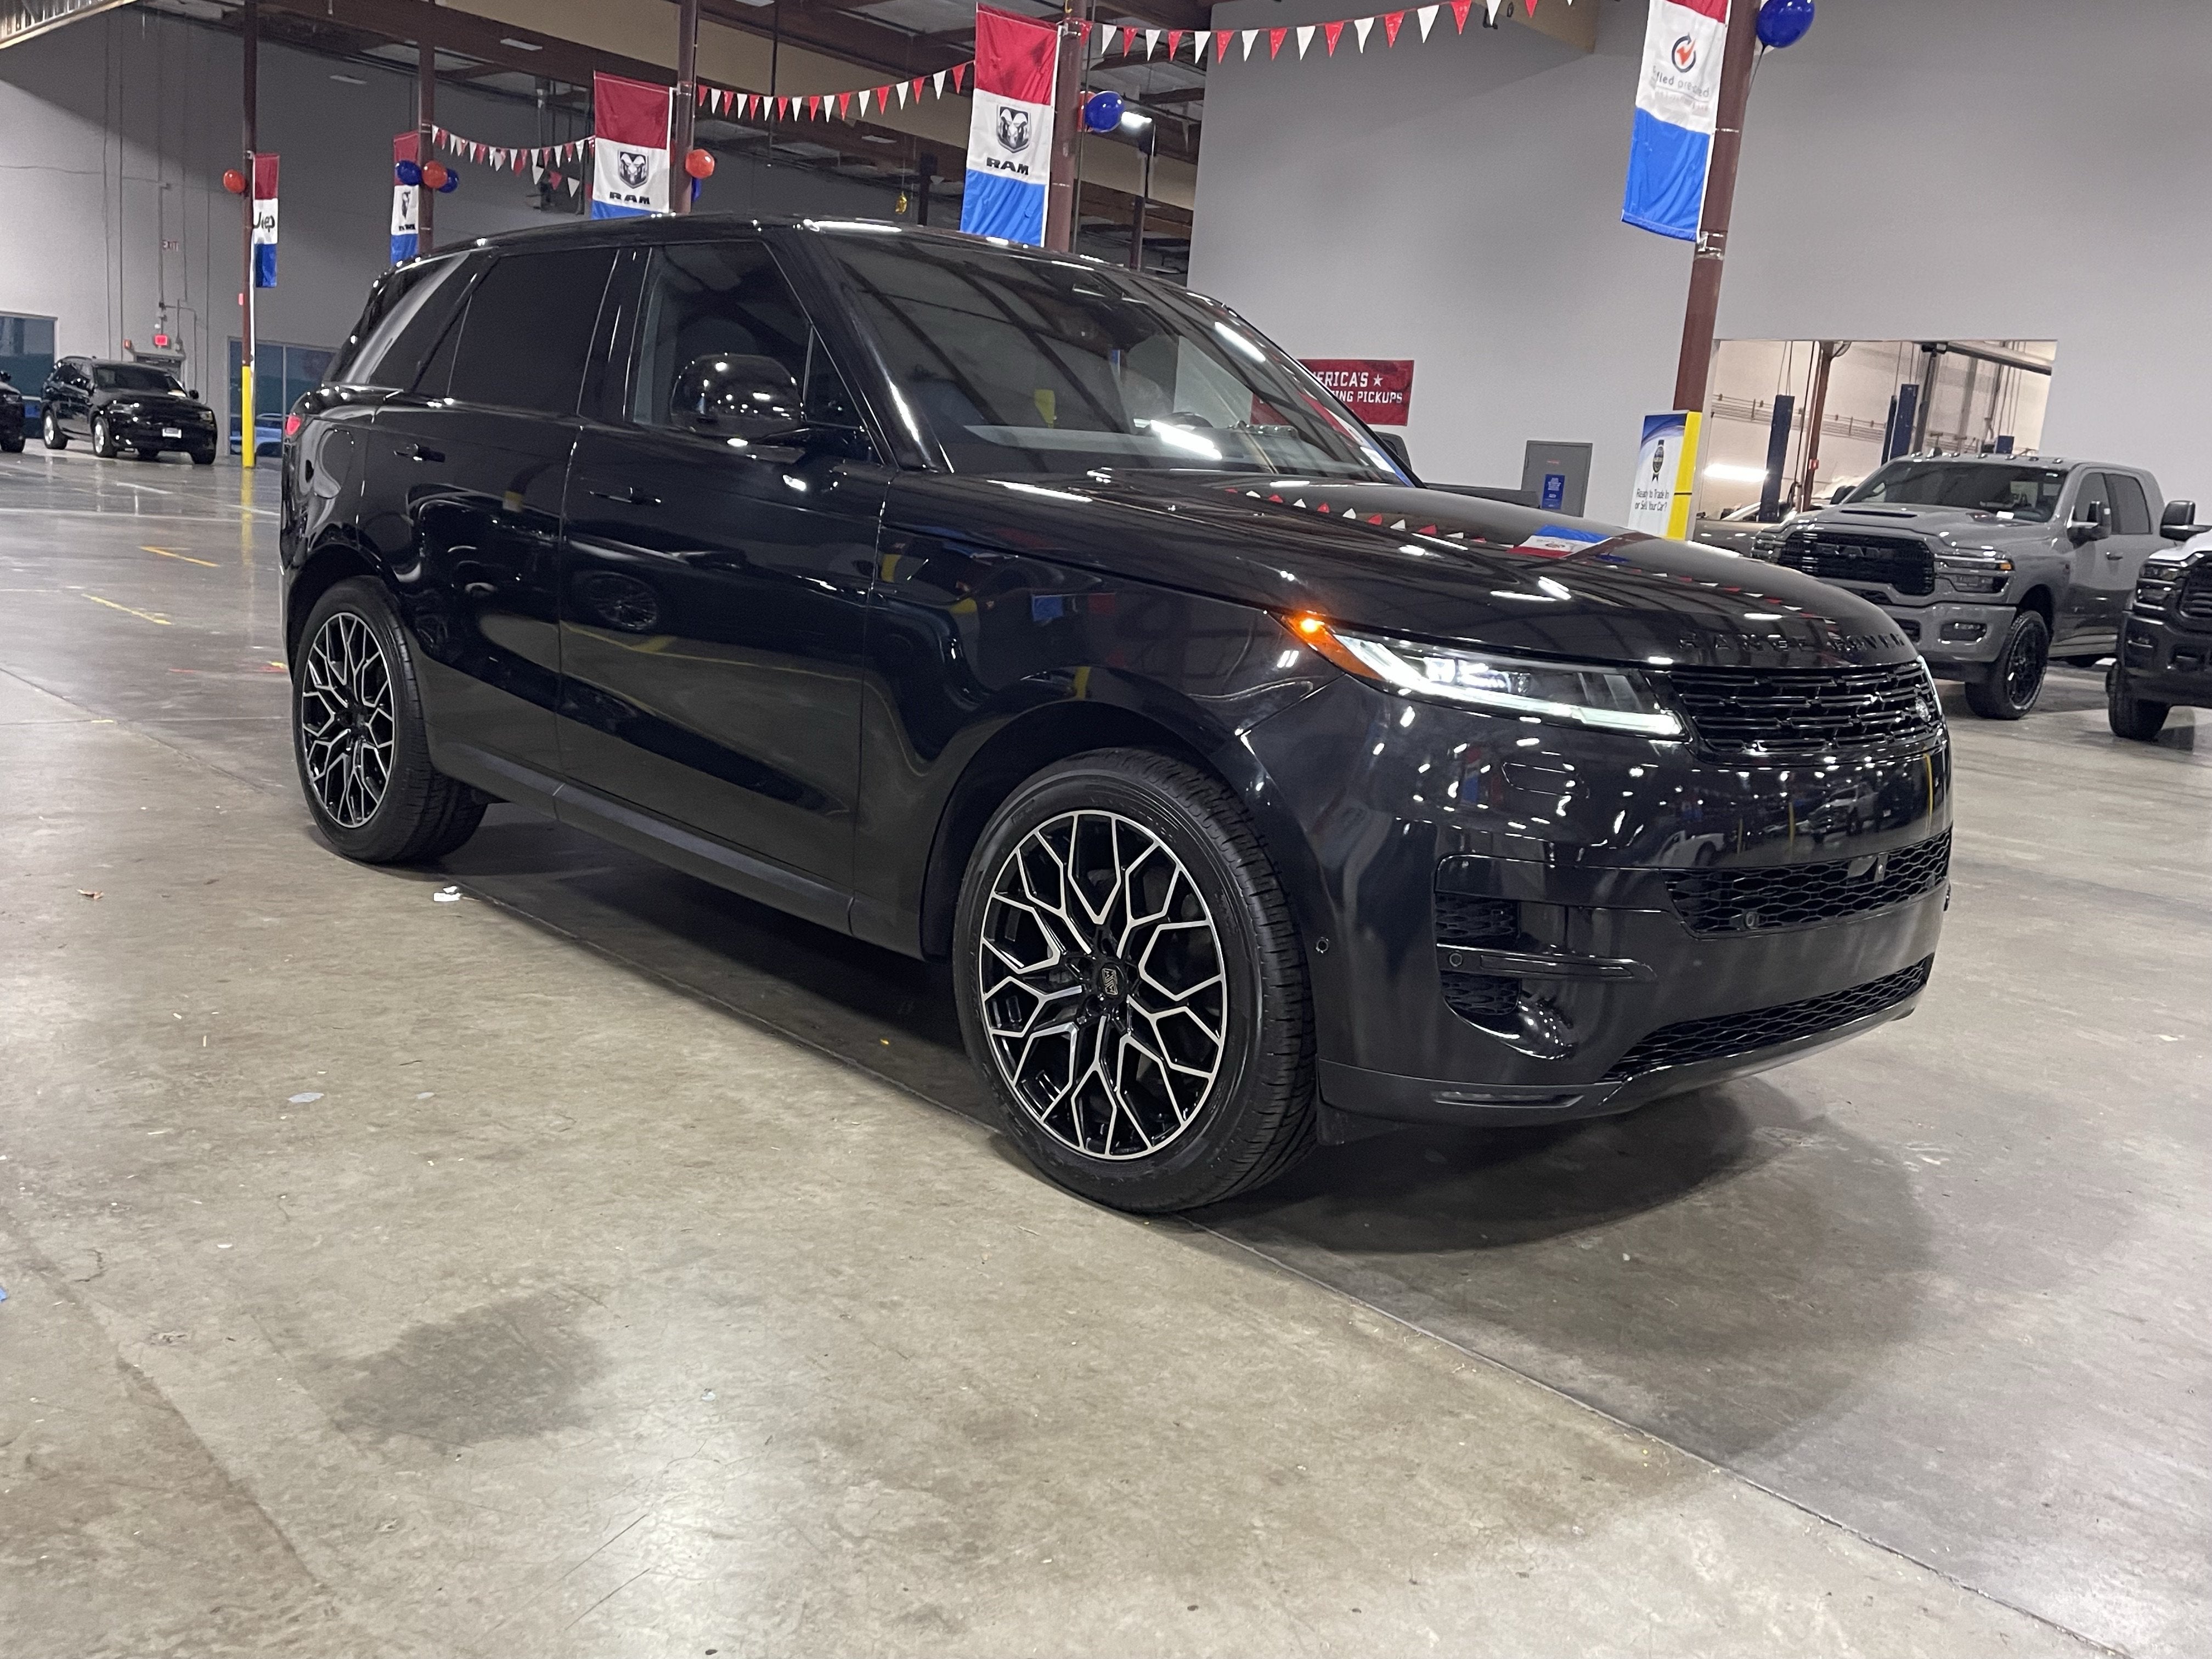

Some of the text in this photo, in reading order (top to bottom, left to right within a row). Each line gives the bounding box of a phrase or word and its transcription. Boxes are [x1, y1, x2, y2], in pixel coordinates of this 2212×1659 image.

[986, 157, 1029, 176] RAM
[609, 191, 650, 205] RAM
[1313, 371, 1369, 387] ERICA'S
[1357, 391, 1403, 404] PICKUPS
[1637, 488, 1648, 500] Ready
[1654, 488, 1664, 499] Trade
[1649, 501, 1657, 511] Your
[1657, 501, 1667, 512] Car?
